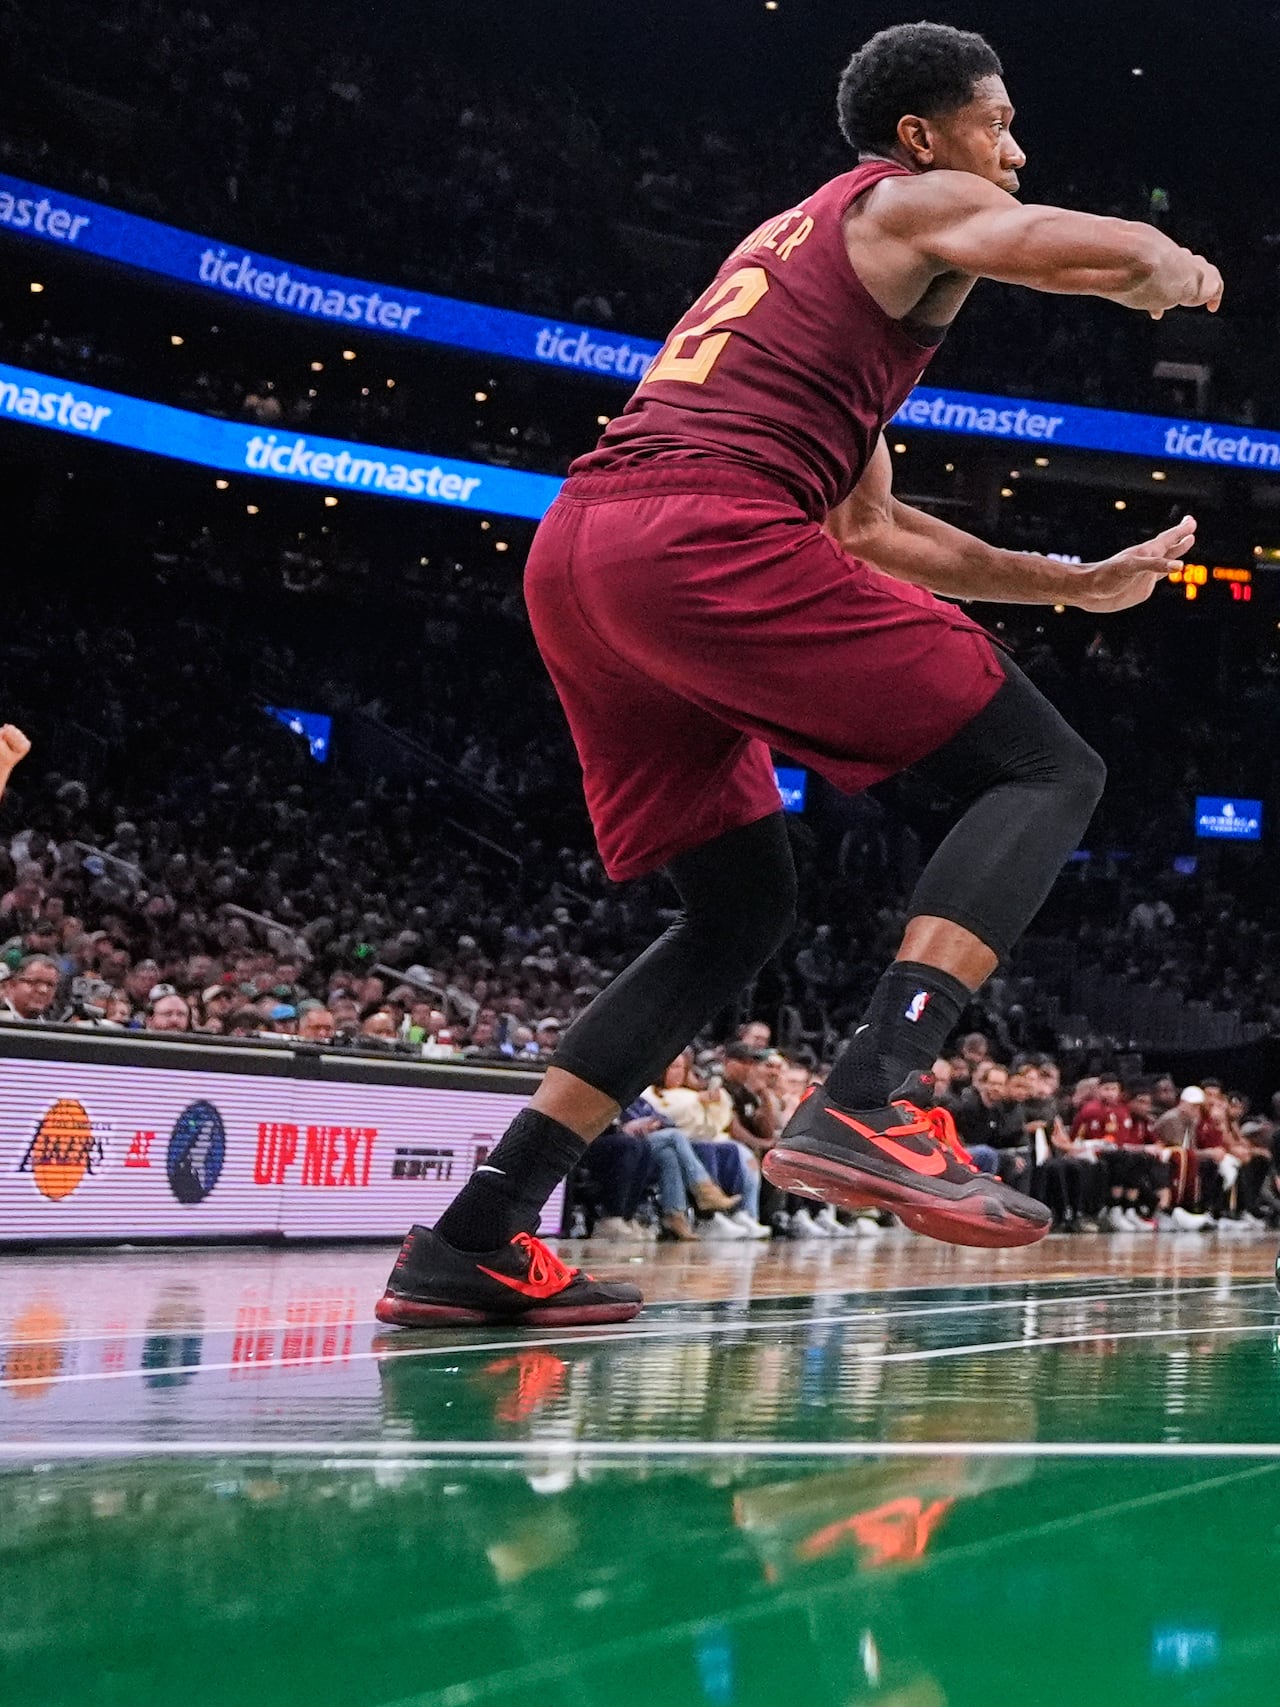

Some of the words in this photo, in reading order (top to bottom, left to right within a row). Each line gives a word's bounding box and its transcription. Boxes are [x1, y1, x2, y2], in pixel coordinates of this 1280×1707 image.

[199, 248, 421, 331] ticketmaster
[245, 434, 482, 502] ticketmaster
[253, 1122, 298, 1185] UP
[301, 1124, 379, 1187] NEXT
